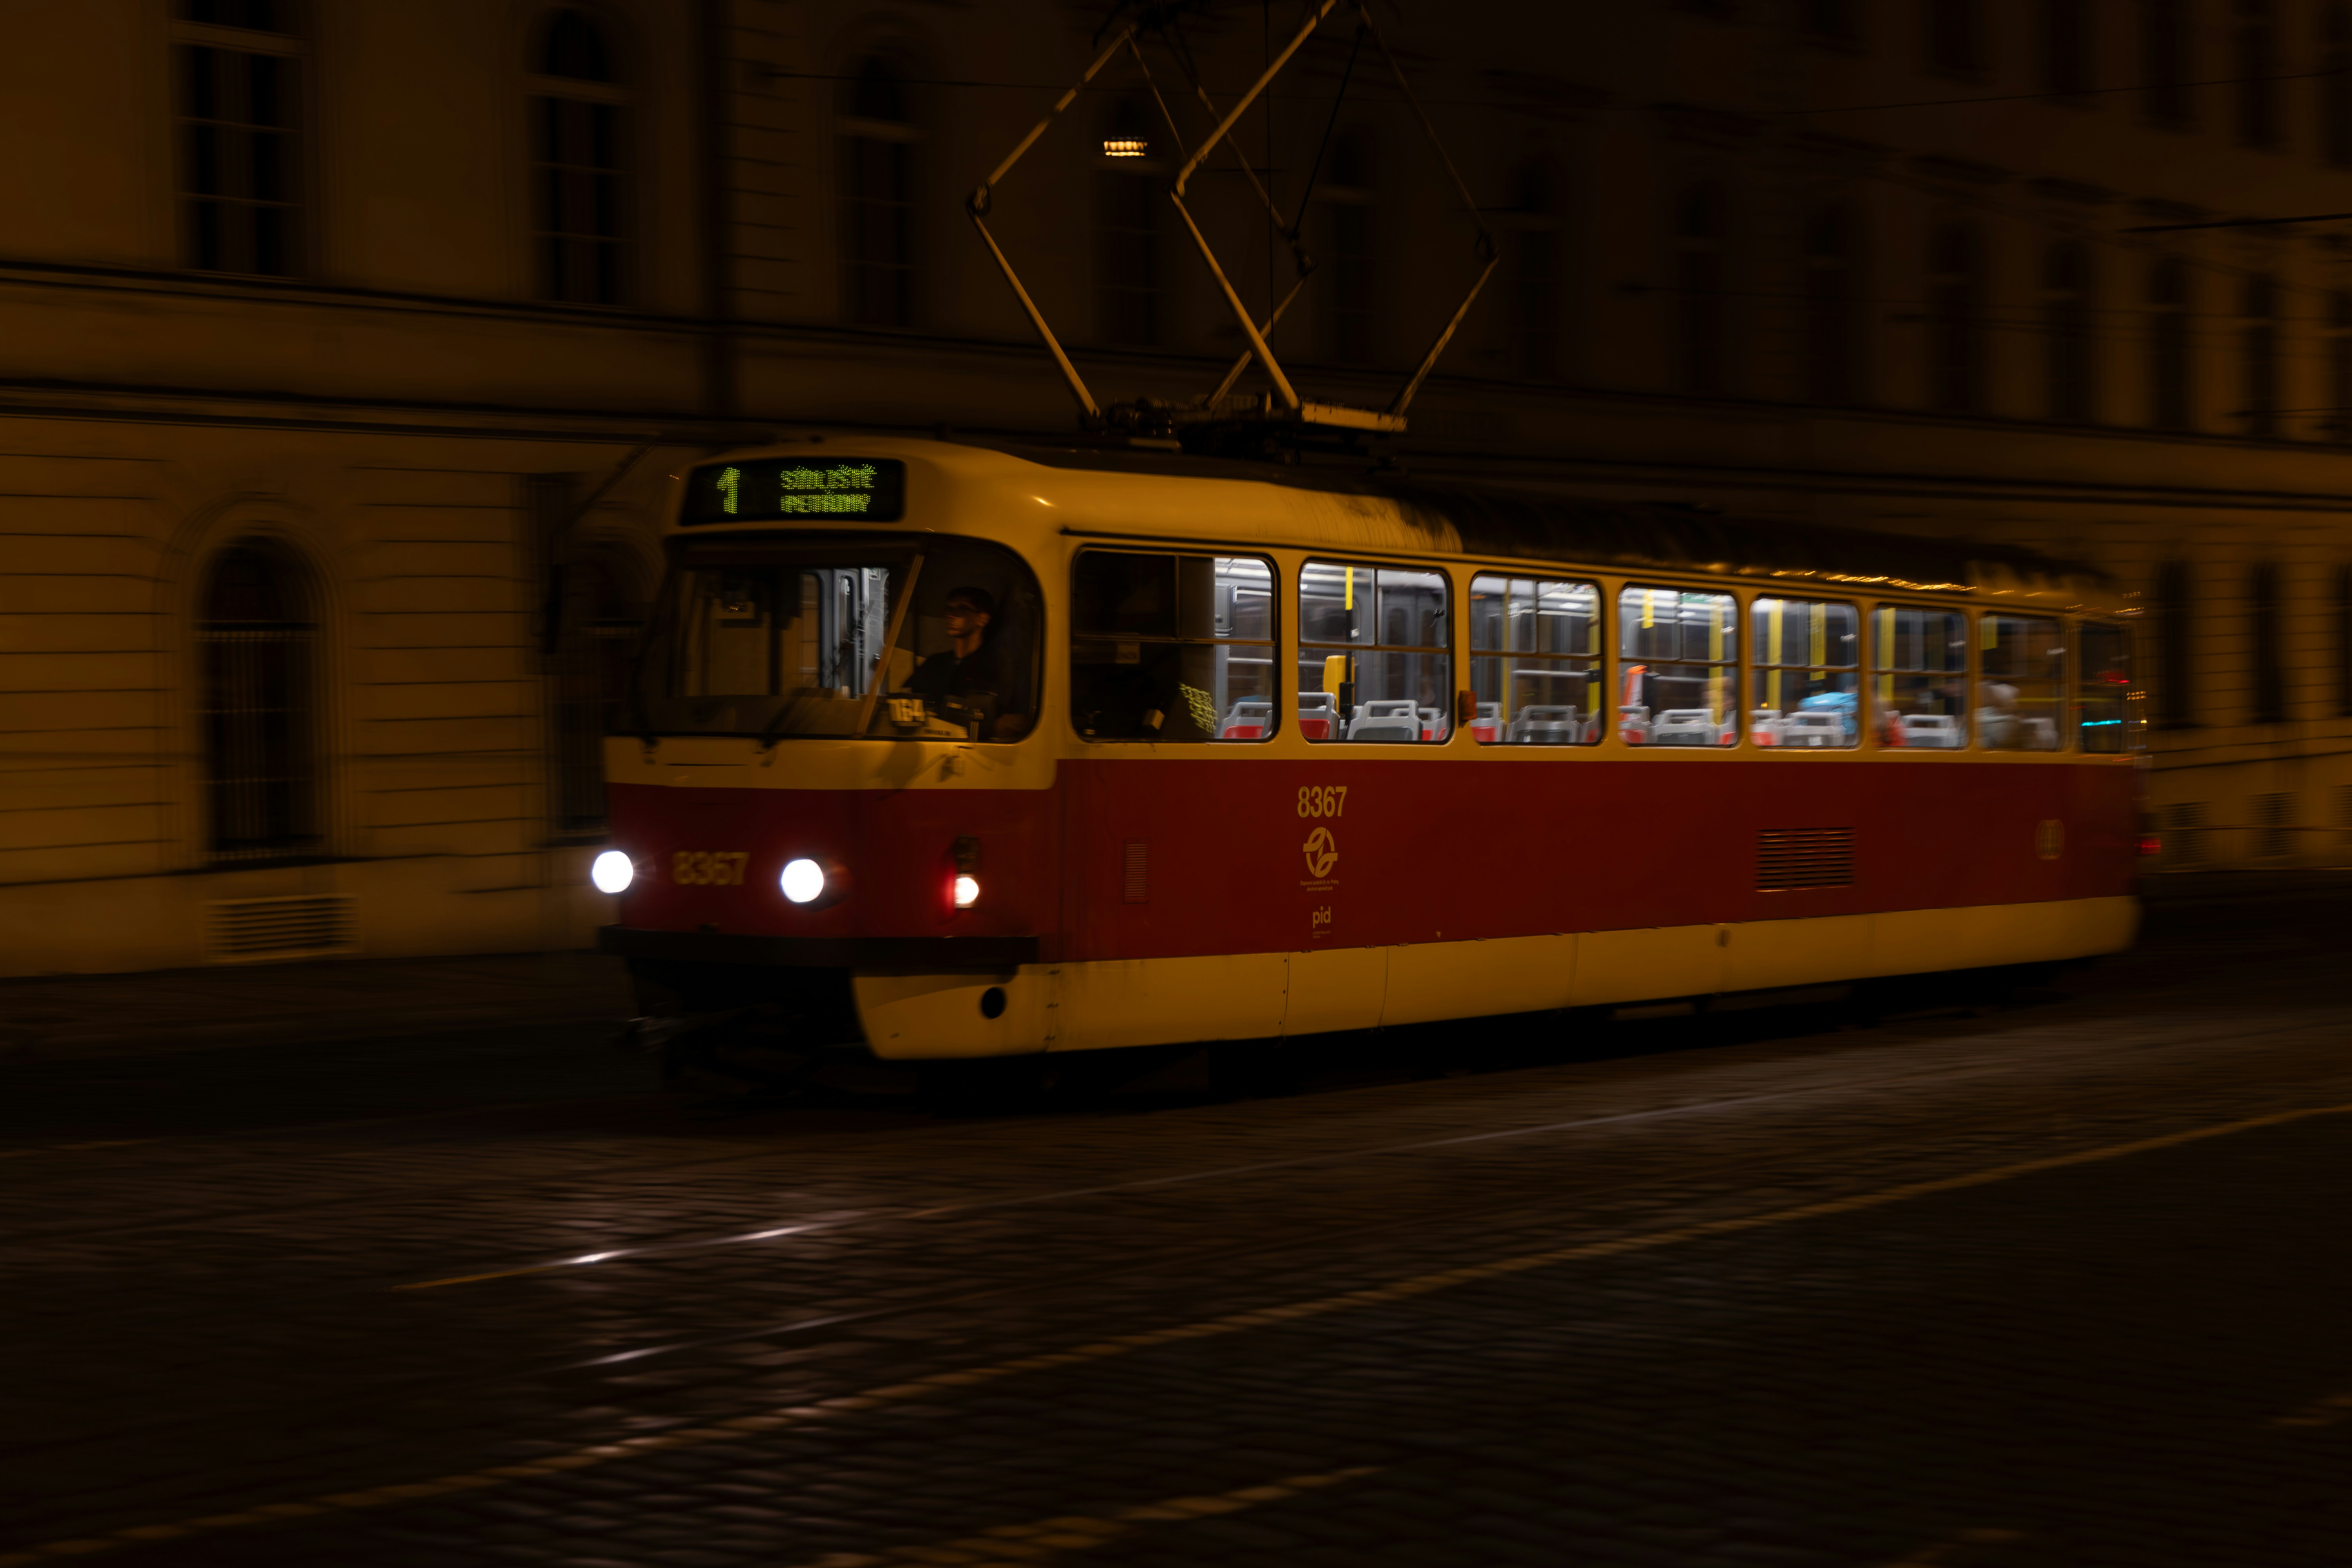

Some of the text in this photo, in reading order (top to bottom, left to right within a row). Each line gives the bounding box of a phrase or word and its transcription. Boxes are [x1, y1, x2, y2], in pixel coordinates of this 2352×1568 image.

[716, 466, 740, 514] 1
[1298, 786, 1347, 818] 8367
[672, 851, 750, 886] 8367
[1313, 906, 1331, 928] pid
